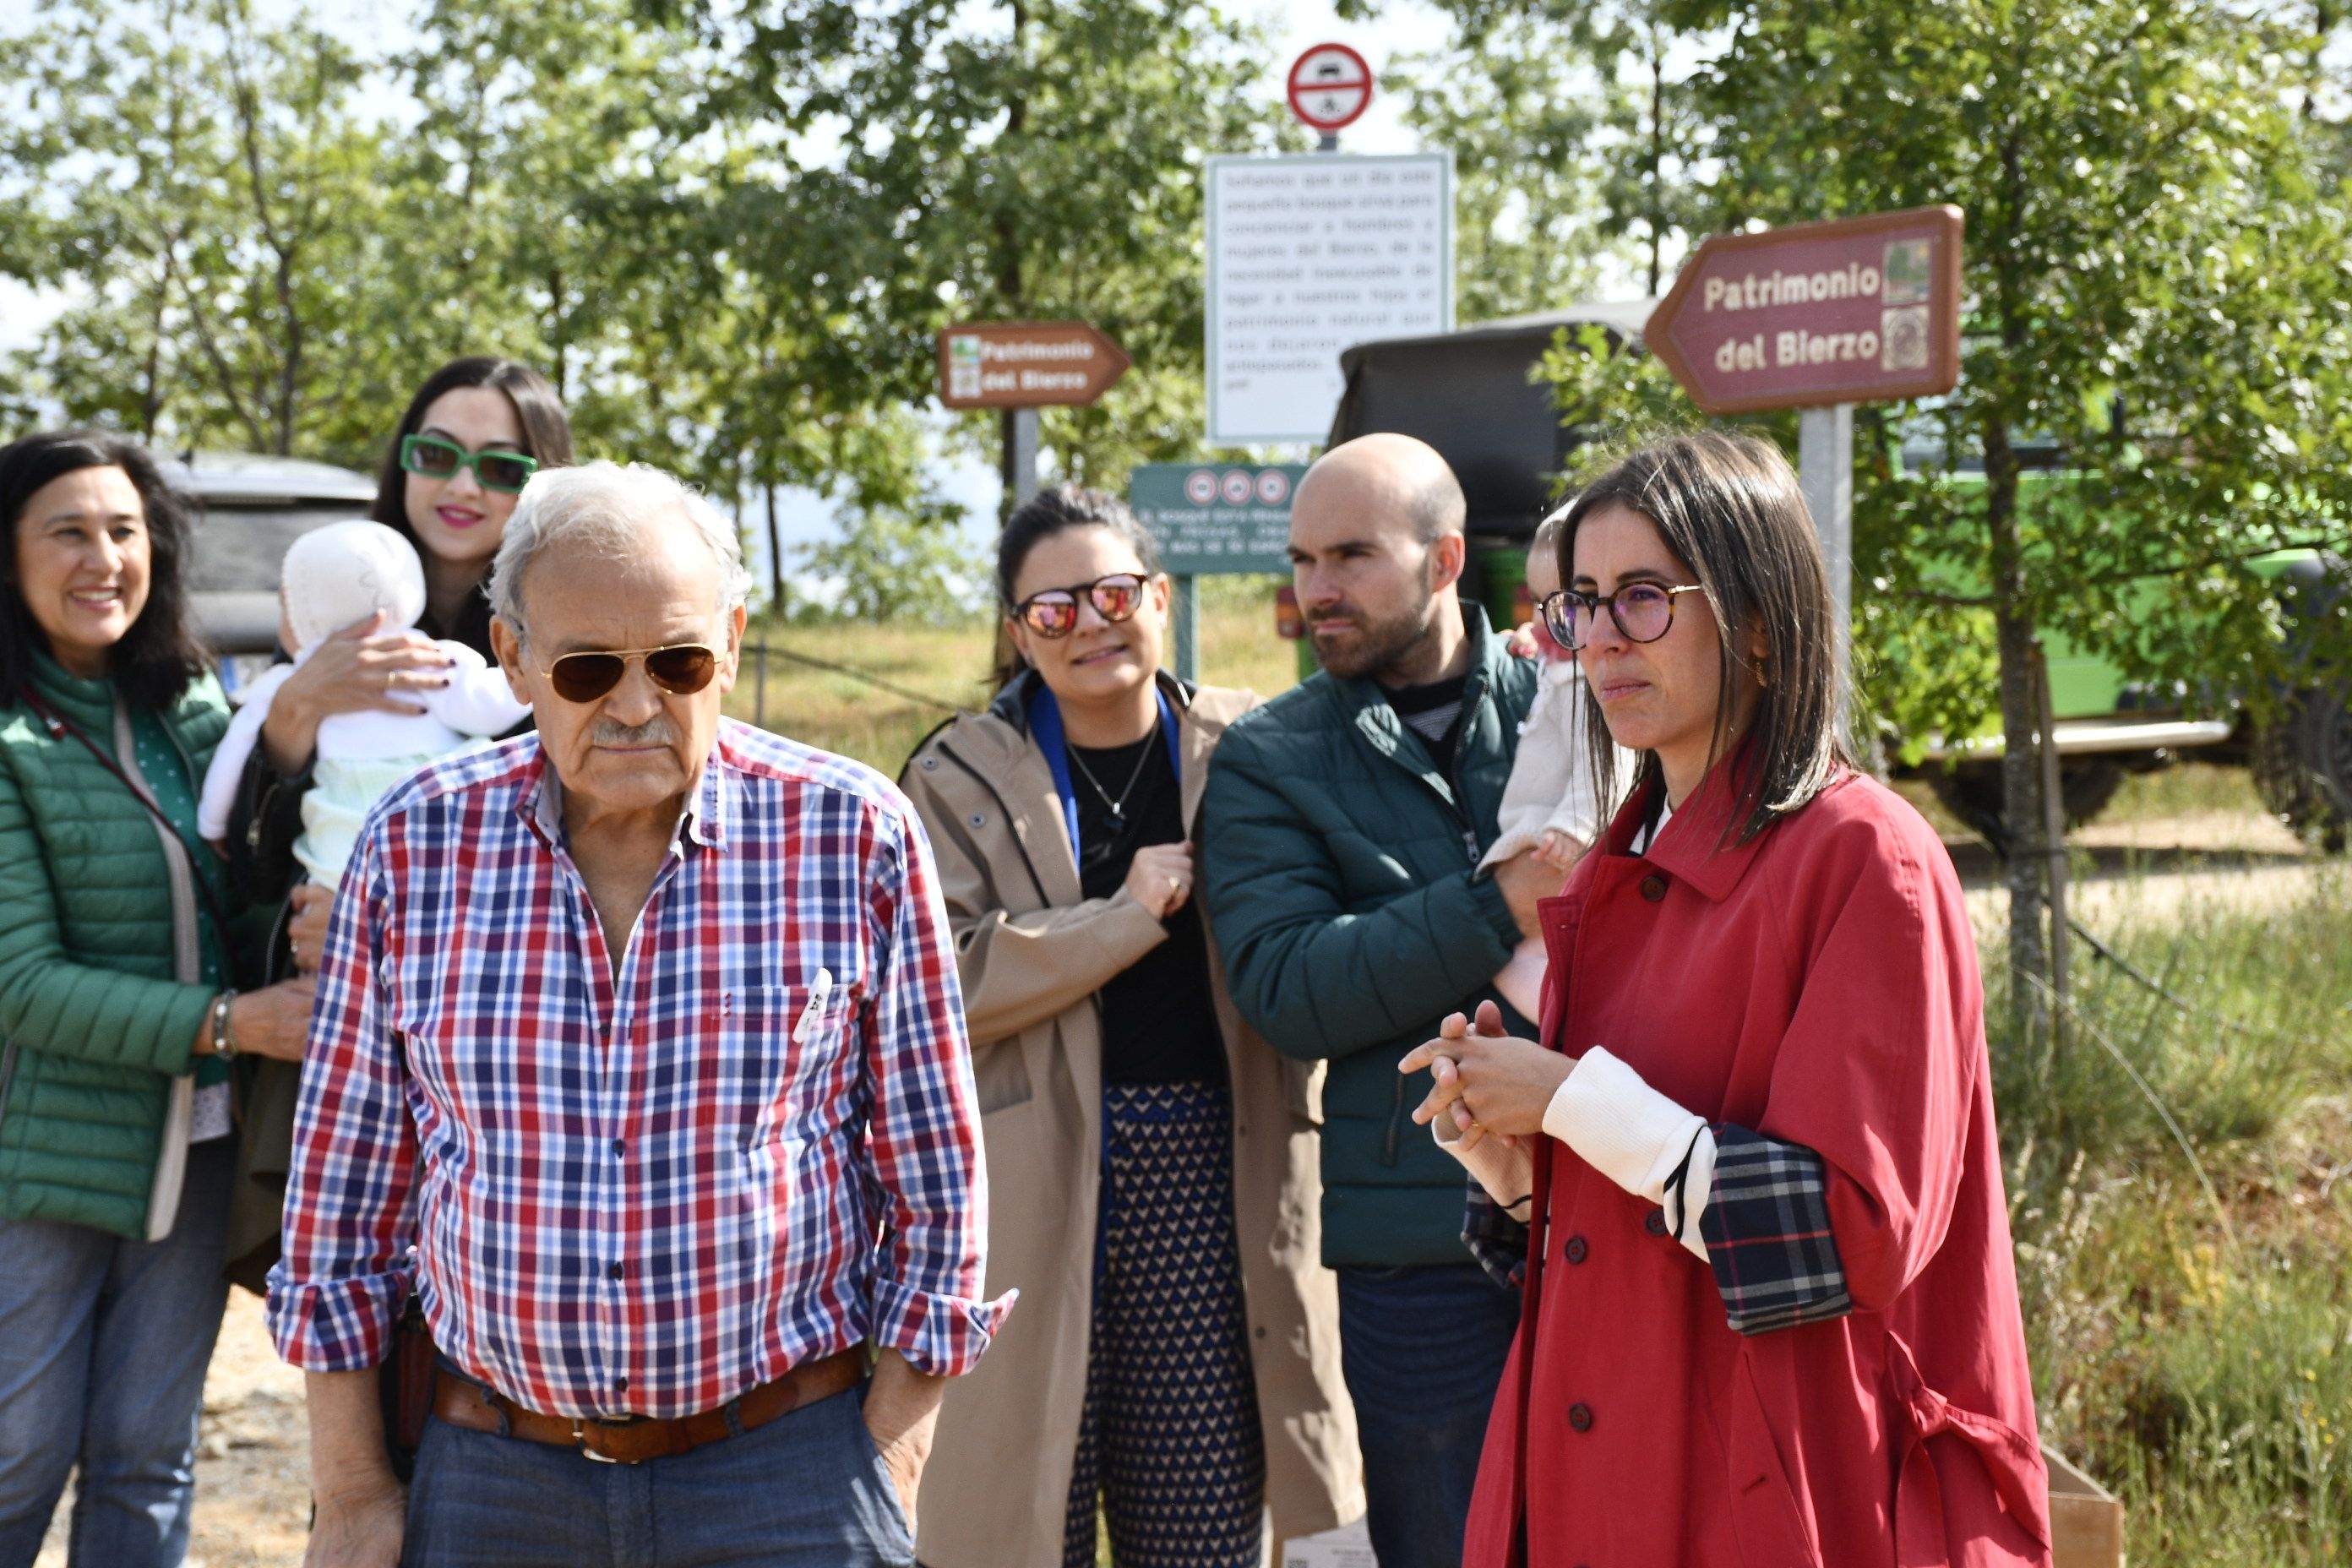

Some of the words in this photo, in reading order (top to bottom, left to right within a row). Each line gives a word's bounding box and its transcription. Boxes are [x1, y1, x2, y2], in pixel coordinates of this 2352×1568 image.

[1703, 262, 1881, 313] Patrimonio
[1715, 334, 1767, 373] del
[1776, 329, 1880, 368] Bierzo
